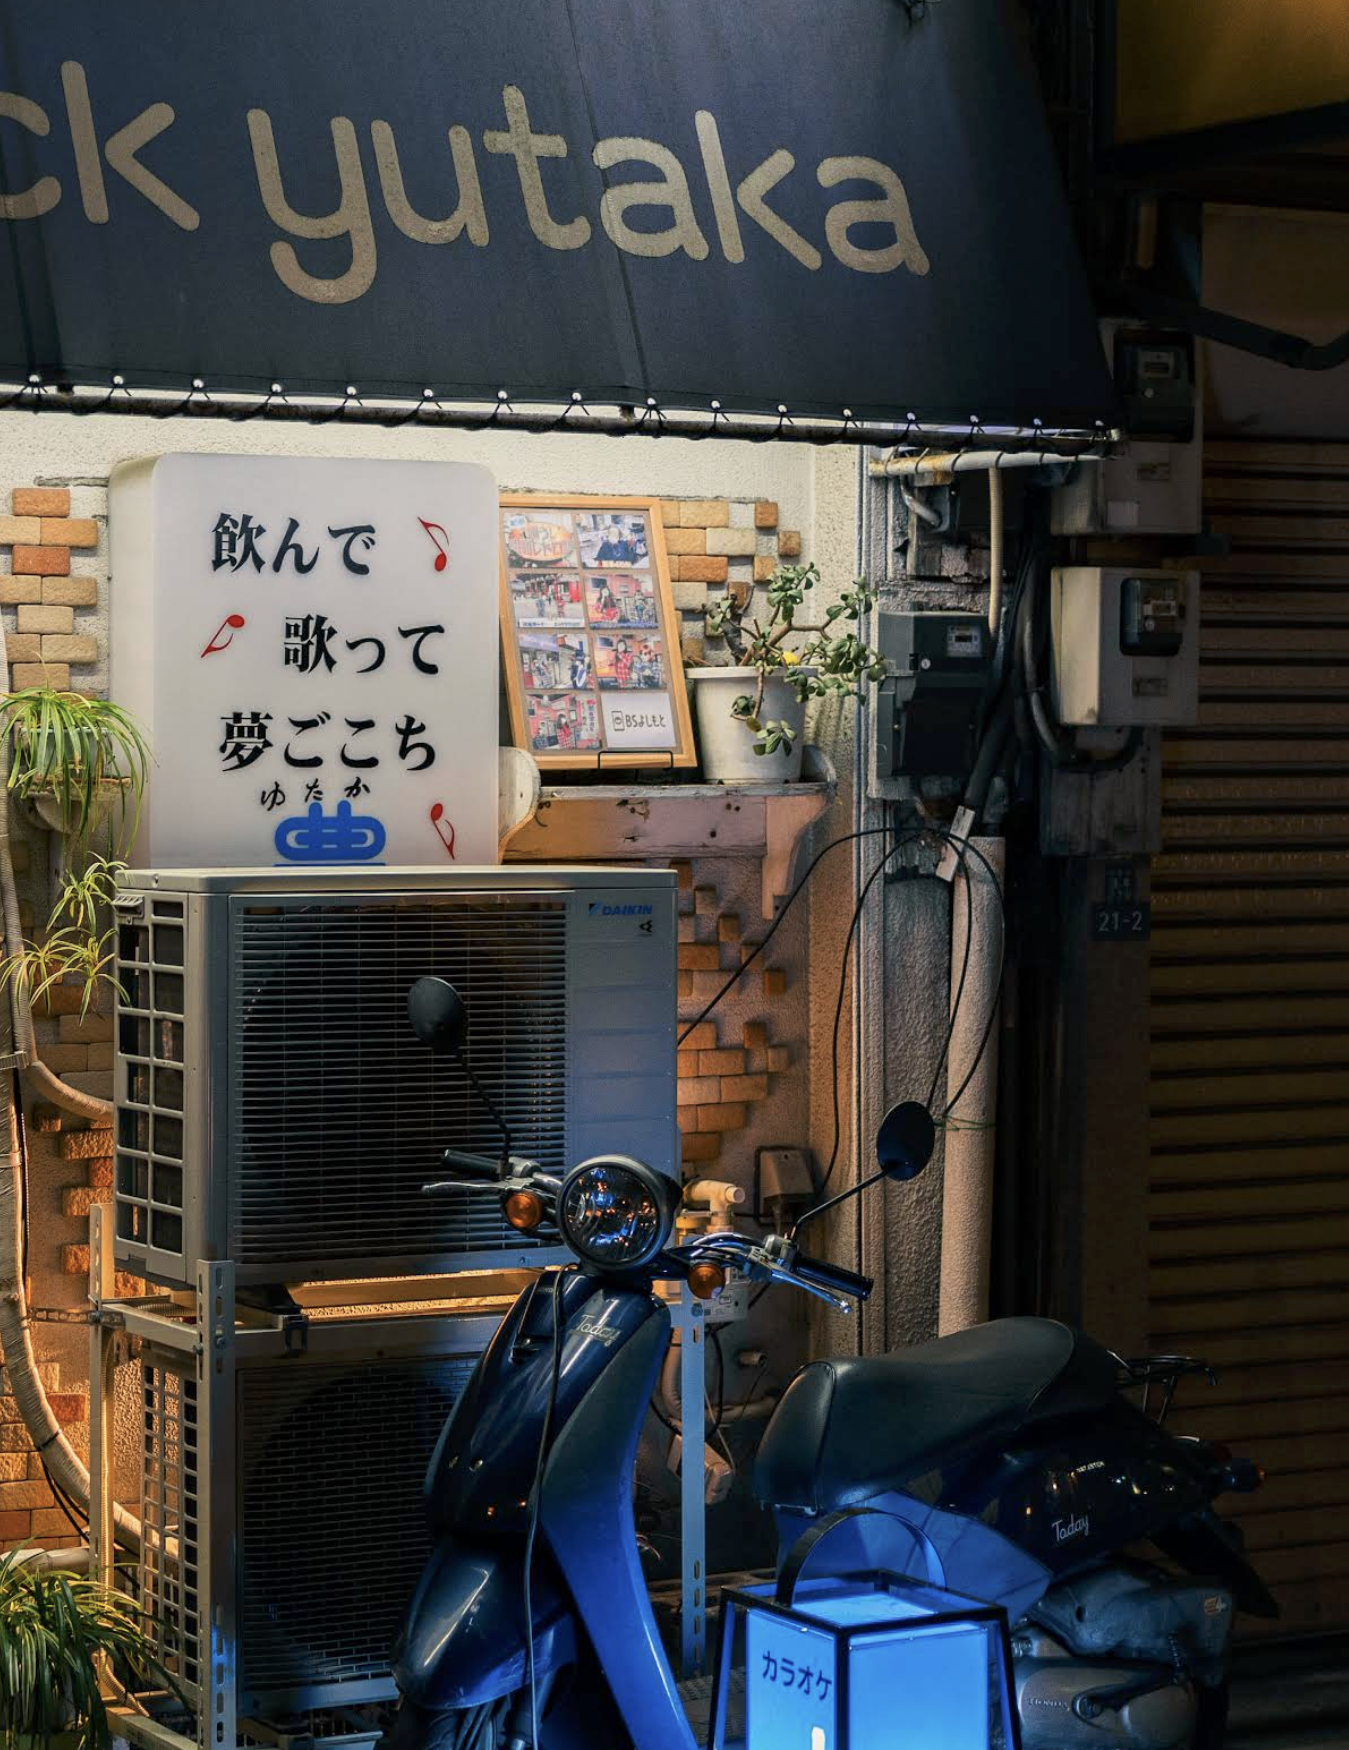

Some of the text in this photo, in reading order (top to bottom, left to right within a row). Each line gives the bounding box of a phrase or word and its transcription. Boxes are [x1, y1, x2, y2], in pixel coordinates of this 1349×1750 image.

[246, 84, 931, 304] yutaka
[210, 512, 376, 577] 飲んで
[283, 614, 445, 675] 歌って
[625, 714, 666, 728] BSよしもと
[218, 711, 436, 772] 夢ごこち
[260, 776, 371, 812] ゆたか
[602, 904, 653, 916] DAIKIN
[1097, 911, 1142, 932] 21-2
[575, 1313, 624, 1347] Today
[1051, 1514, 1090, 1543] Today
[761, 1650, 833, 1701] カラオケ
